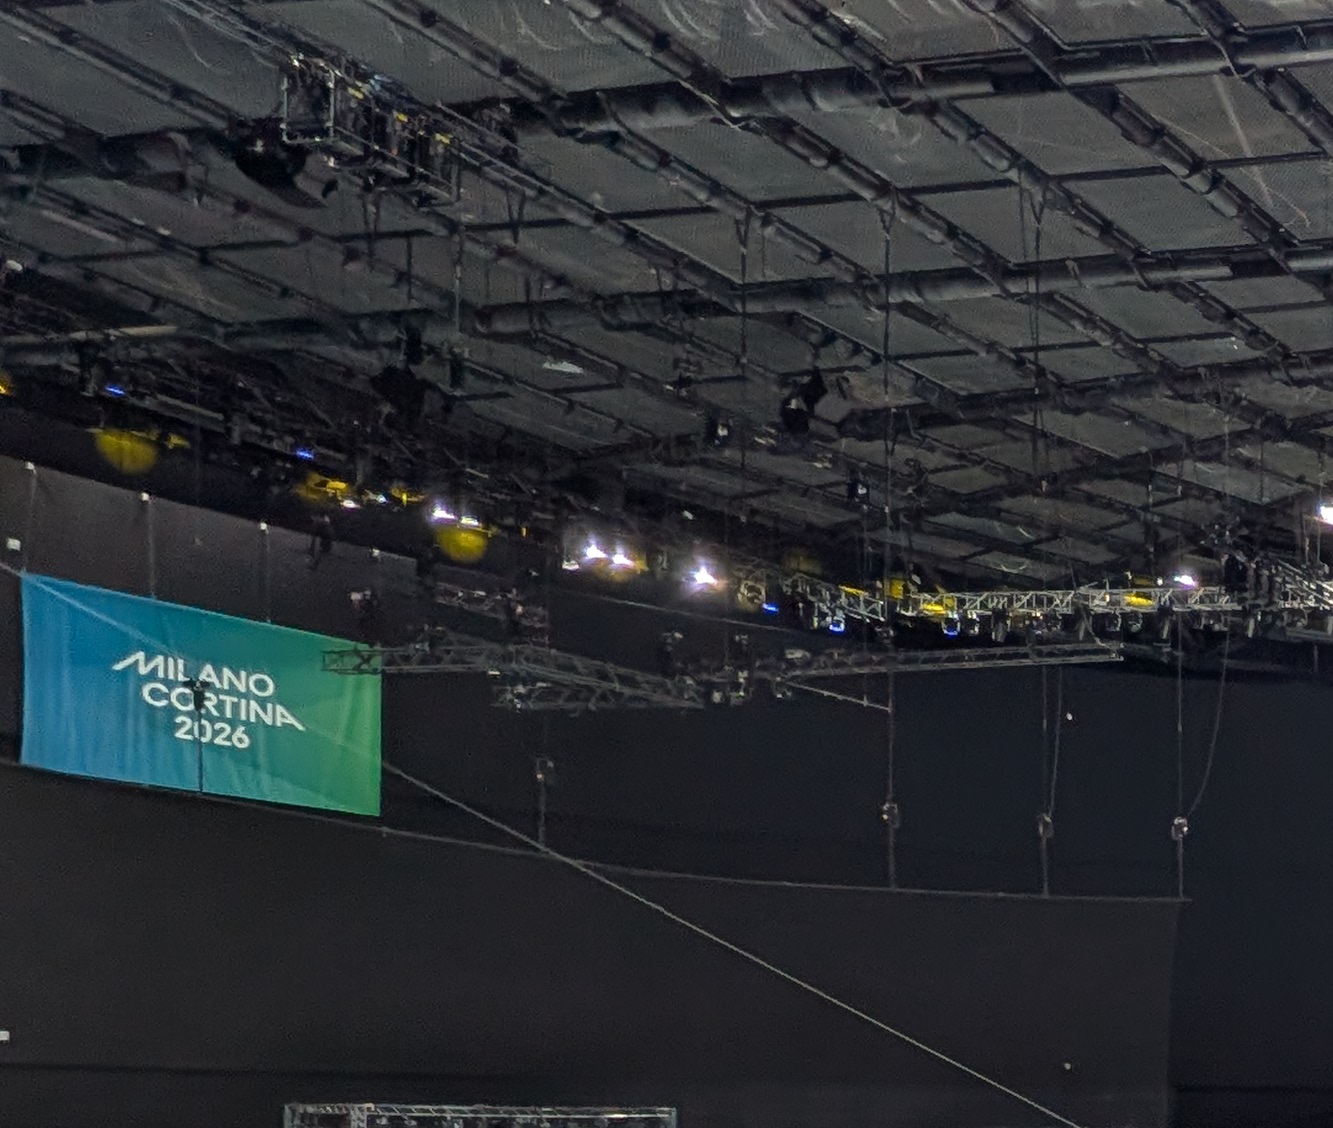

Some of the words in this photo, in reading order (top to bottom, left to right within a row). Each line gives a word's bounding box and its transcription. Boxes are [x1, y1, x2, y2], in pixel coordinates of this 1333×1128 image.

[112, 650, 276, 697] MILANO
[142, 682, 306, 731] CORTINA
[174, 715, 251, 749] 2026
